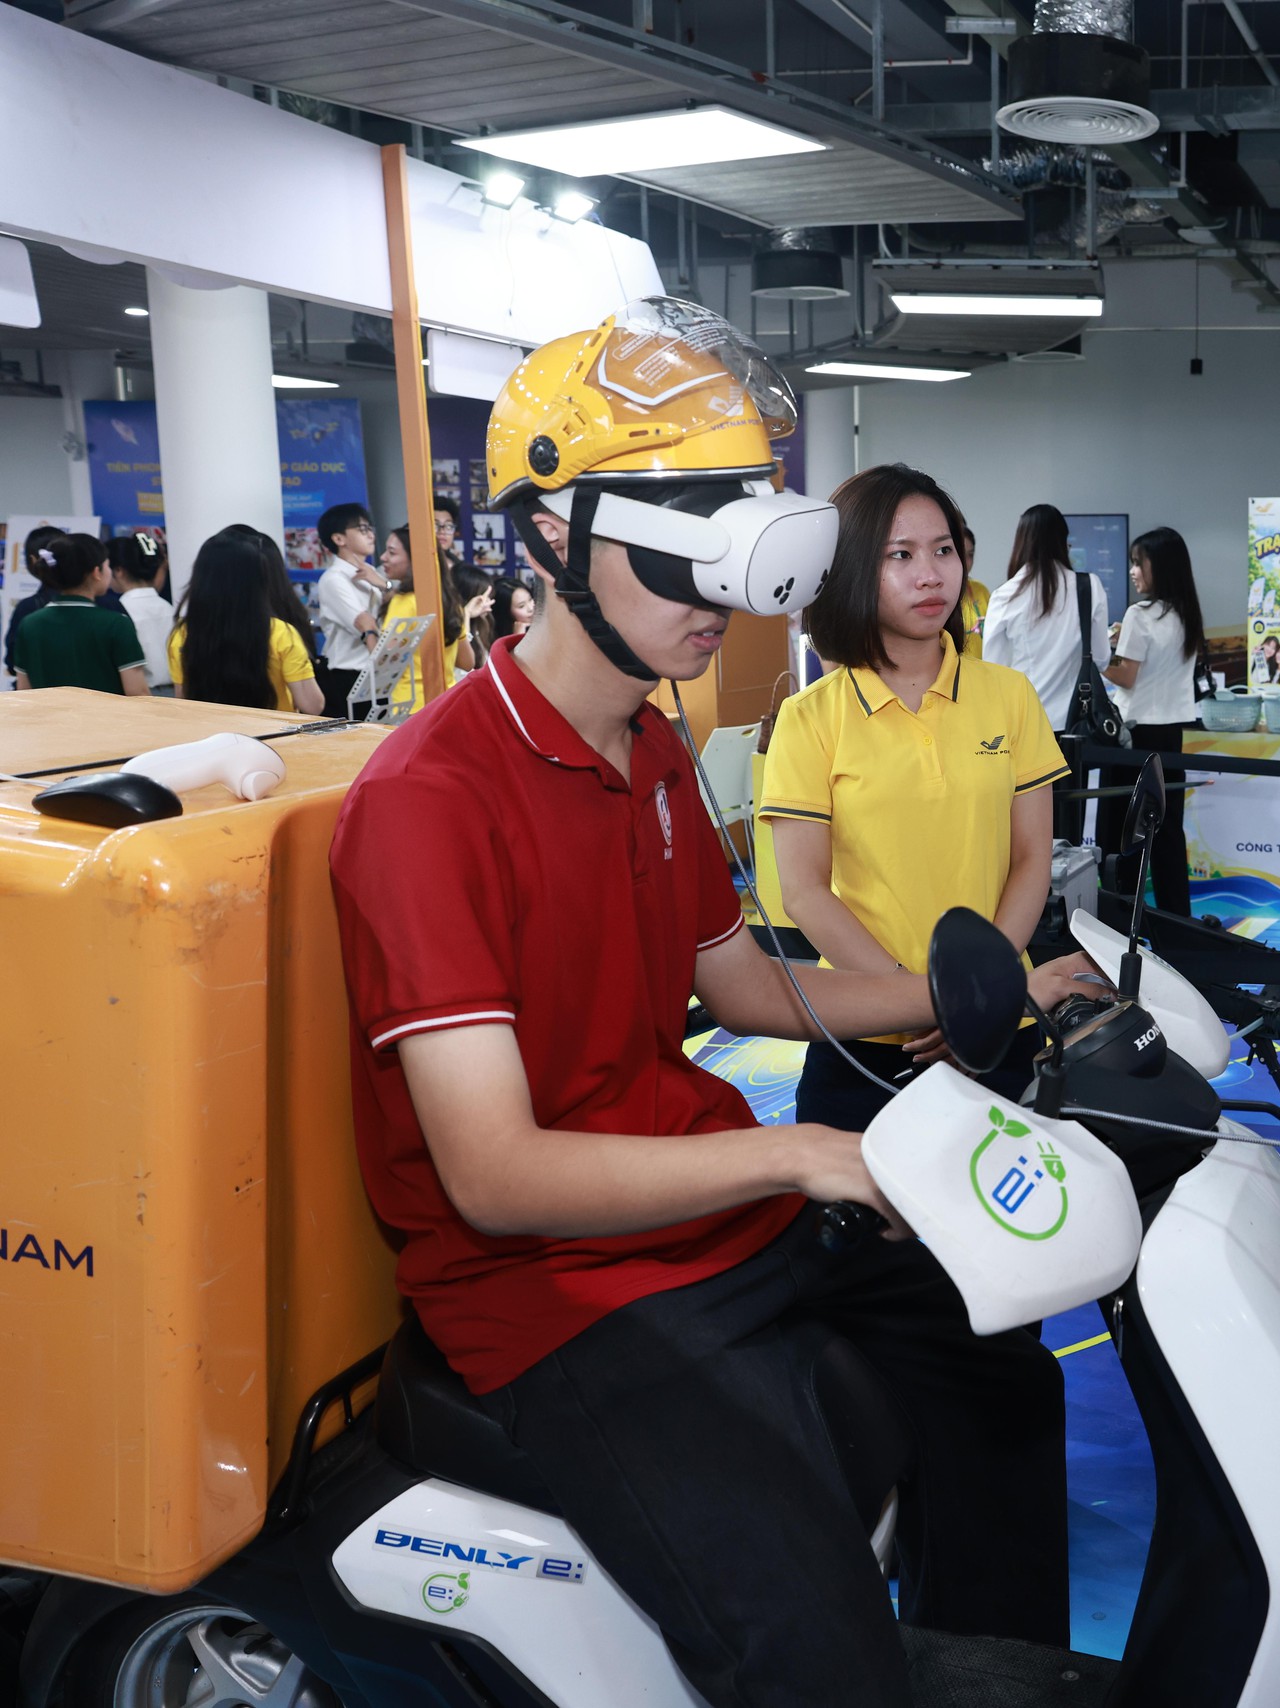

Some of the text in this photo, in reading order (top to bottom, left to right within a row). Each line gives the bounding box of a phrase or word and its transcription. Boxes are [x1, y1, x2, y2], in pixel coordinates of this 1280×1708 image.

[711, 420, 746, 431] VIETNAM
[291, 460, 319, 473] GIÁO
[321, 462, 346, 475] DỤC
[1236, 841, 1273, 853] CÔNG
[375, 1529, 535, 1570] BENLY
